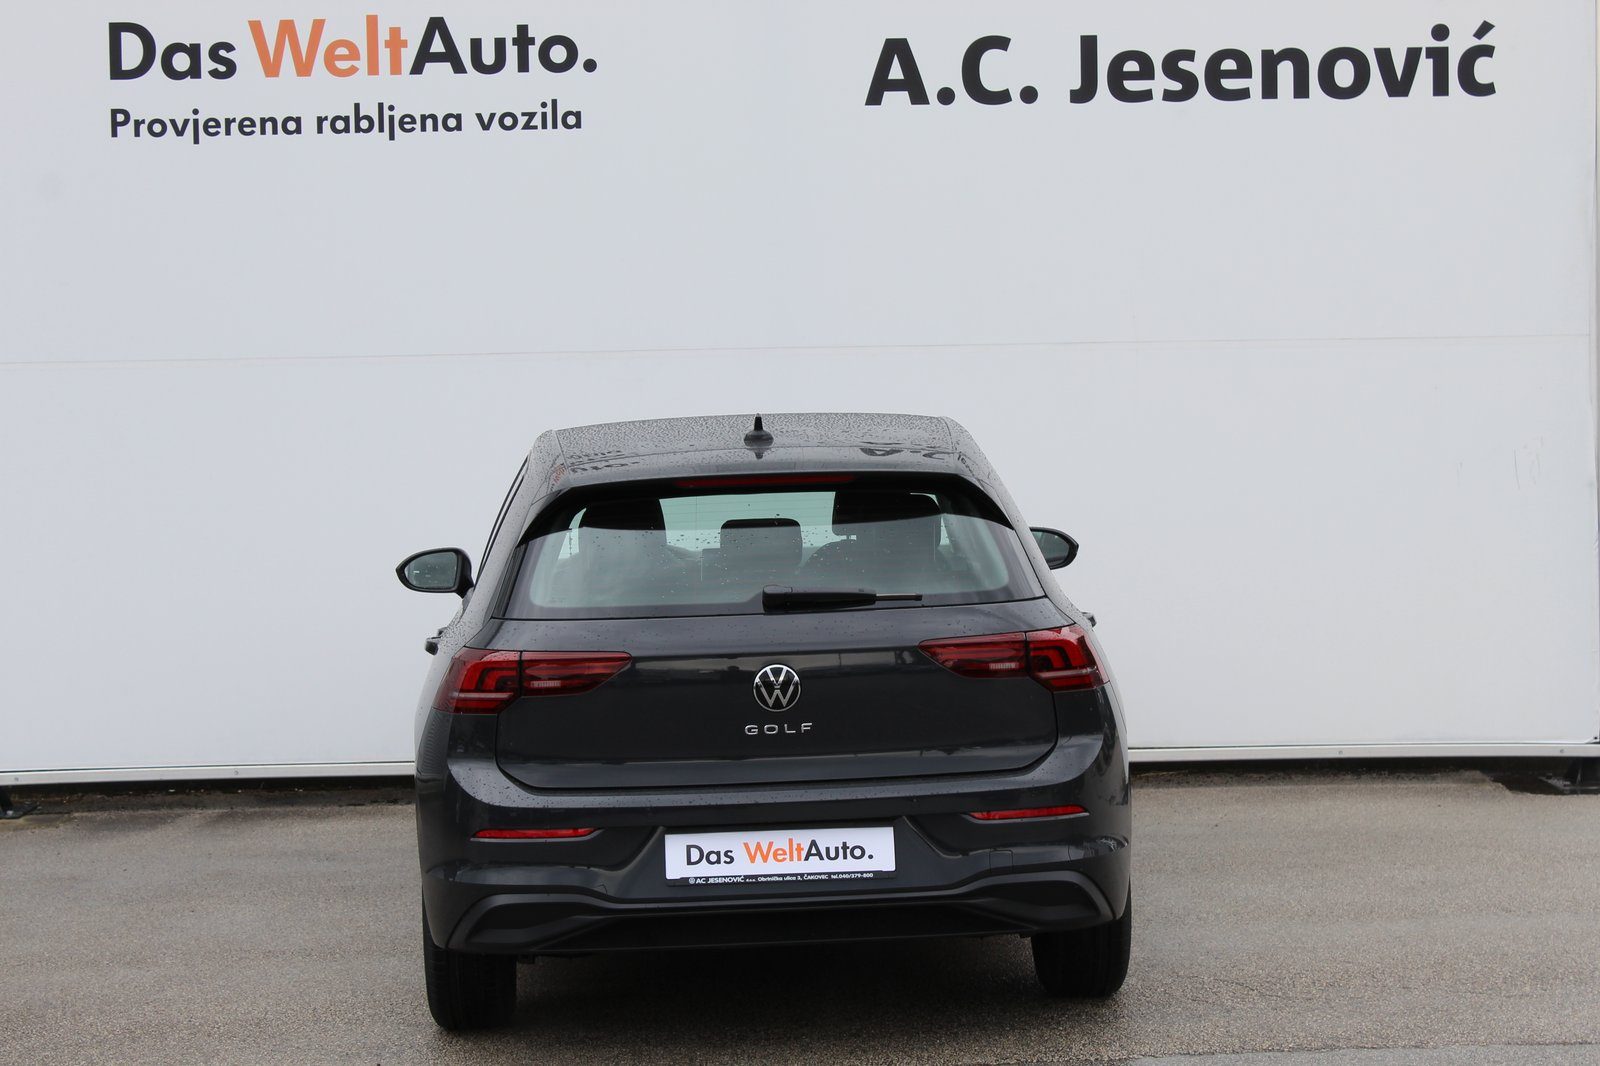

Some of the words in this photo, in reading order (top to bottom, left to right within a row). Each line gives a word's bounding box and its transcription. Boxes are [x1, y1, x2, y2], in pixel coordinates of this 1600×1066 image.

[109, 22, 236, 81] Das
[248, 15, 597, 78] WeltAuto.
[865, 35, 1038, 107] A.C.
[1070, 20, 1496, 104] Jesenović
[111, 108, 302, 145] Provjerena
[316, 102, 463, 142] rabljena
[475, 99, 582, 131] vozila
[744, 722, 813, 735] GOLF
[686, 844, 735, 866] Das
[744, 838, 874, 864] WeltAuto.
[695, 877, 706, 885] AC
[707, 875, 745, 884] JESENOVIĆ
